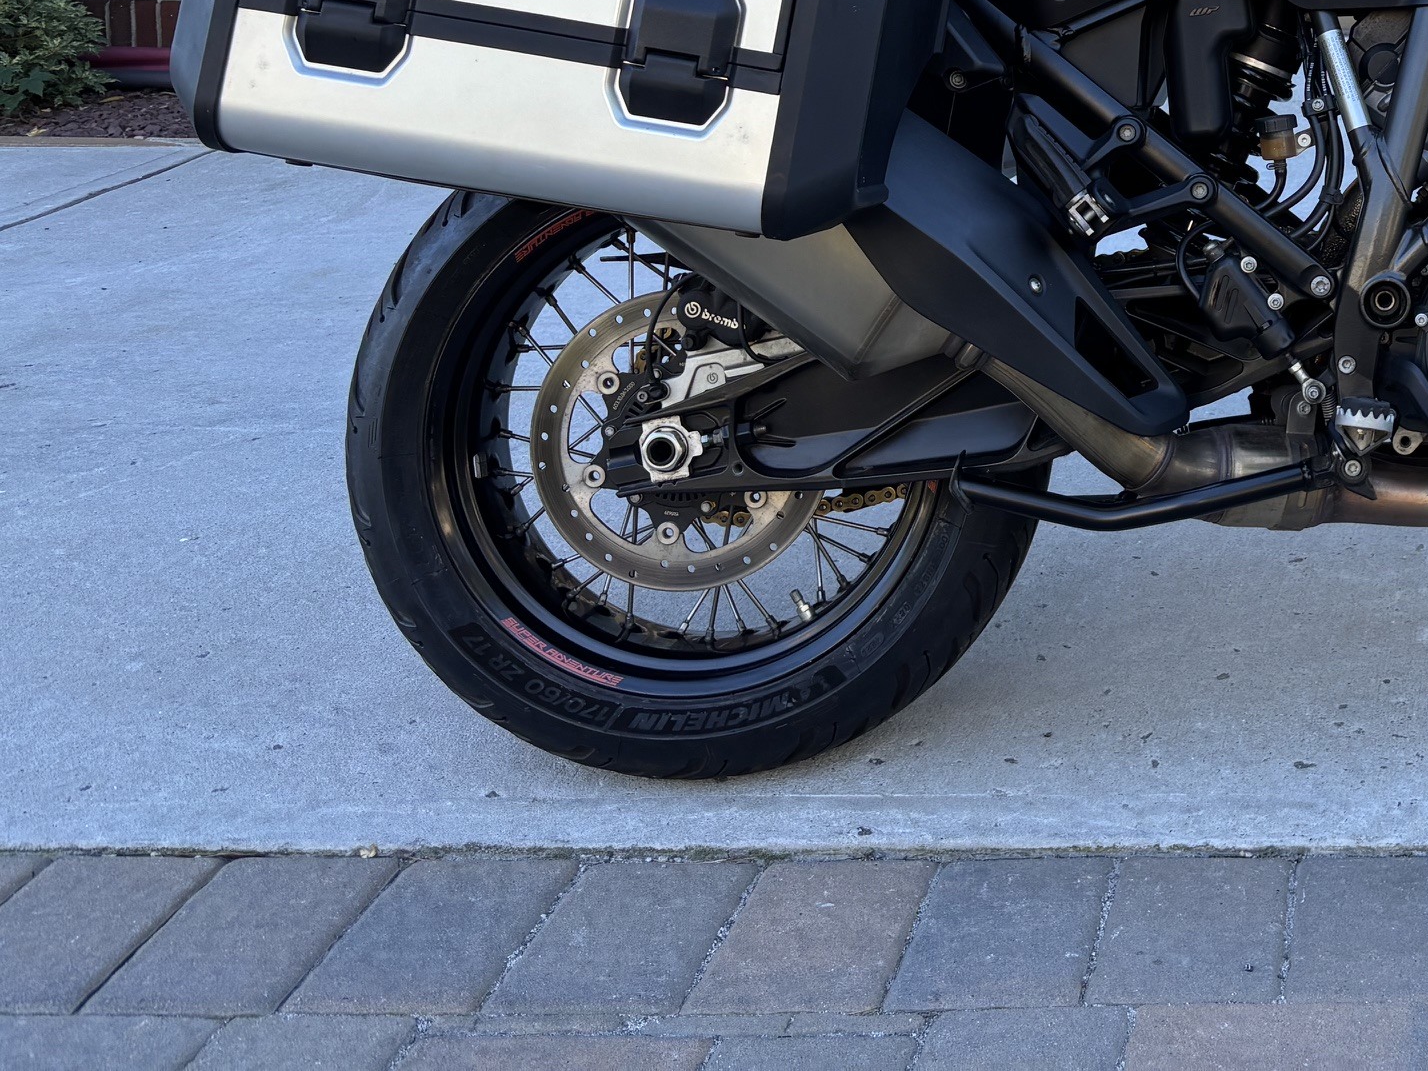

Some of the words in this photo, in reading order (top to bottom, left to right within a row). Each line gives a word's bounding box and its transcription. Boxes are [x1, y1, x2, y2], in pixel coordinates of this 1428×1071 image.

[515, 209, 583, 263] ADVENTURE
[702, 308, 746, 330] bremb
[462, 634, 492, 655] 17
[501, 616, 547, 652] SUPER
[547, 646, 624, 687] ADVENTURE
[487, 654, 525, 681] ZR
[525, 678, 610, 721] 170/60
[627, 692, 791, 732] MICHELIN
